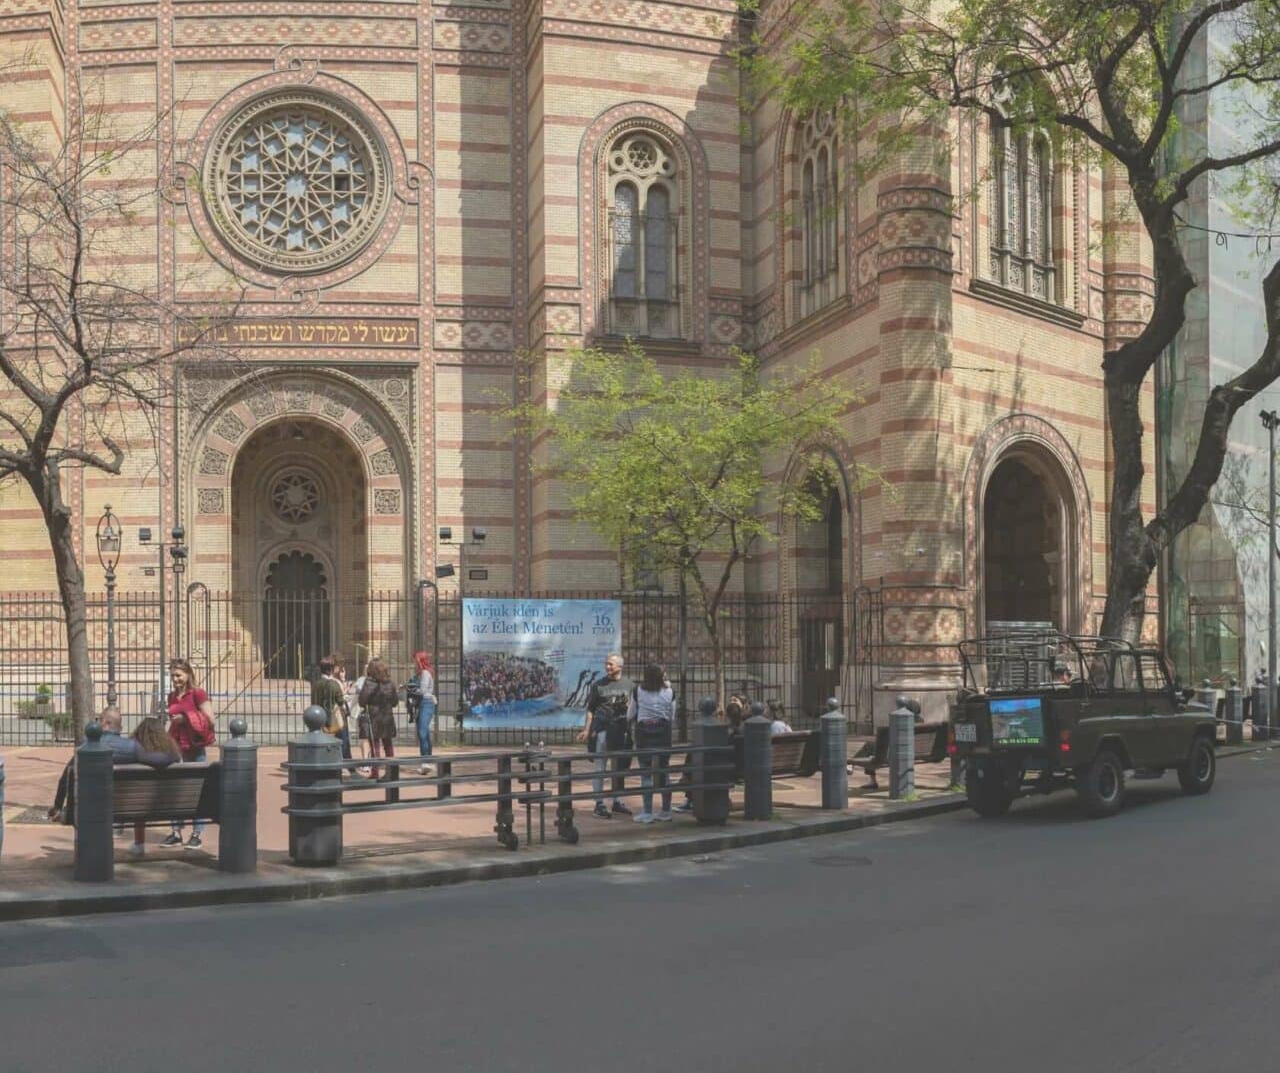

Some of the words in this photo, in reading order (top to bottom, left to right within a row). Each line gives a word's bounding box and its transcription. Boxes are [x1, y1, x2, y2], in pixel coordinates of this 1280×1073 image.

[233, 324, 293, 341] ושכנתי
[297, 324, 350, 343] מקדש
[353, 321, 369, 342] לי
[371, 325, 416, 342] ועשו
[467, 604, 508, 619] Várjuk
[513, 603, 539, 617] idén
[543, 604, 554, 617] is
[472, 624, 487, 634] az
[491, 618, 517, 634] Élet
[523, 620, 584, 635] Menetén!
[593, 614, 613, 626] 16.
